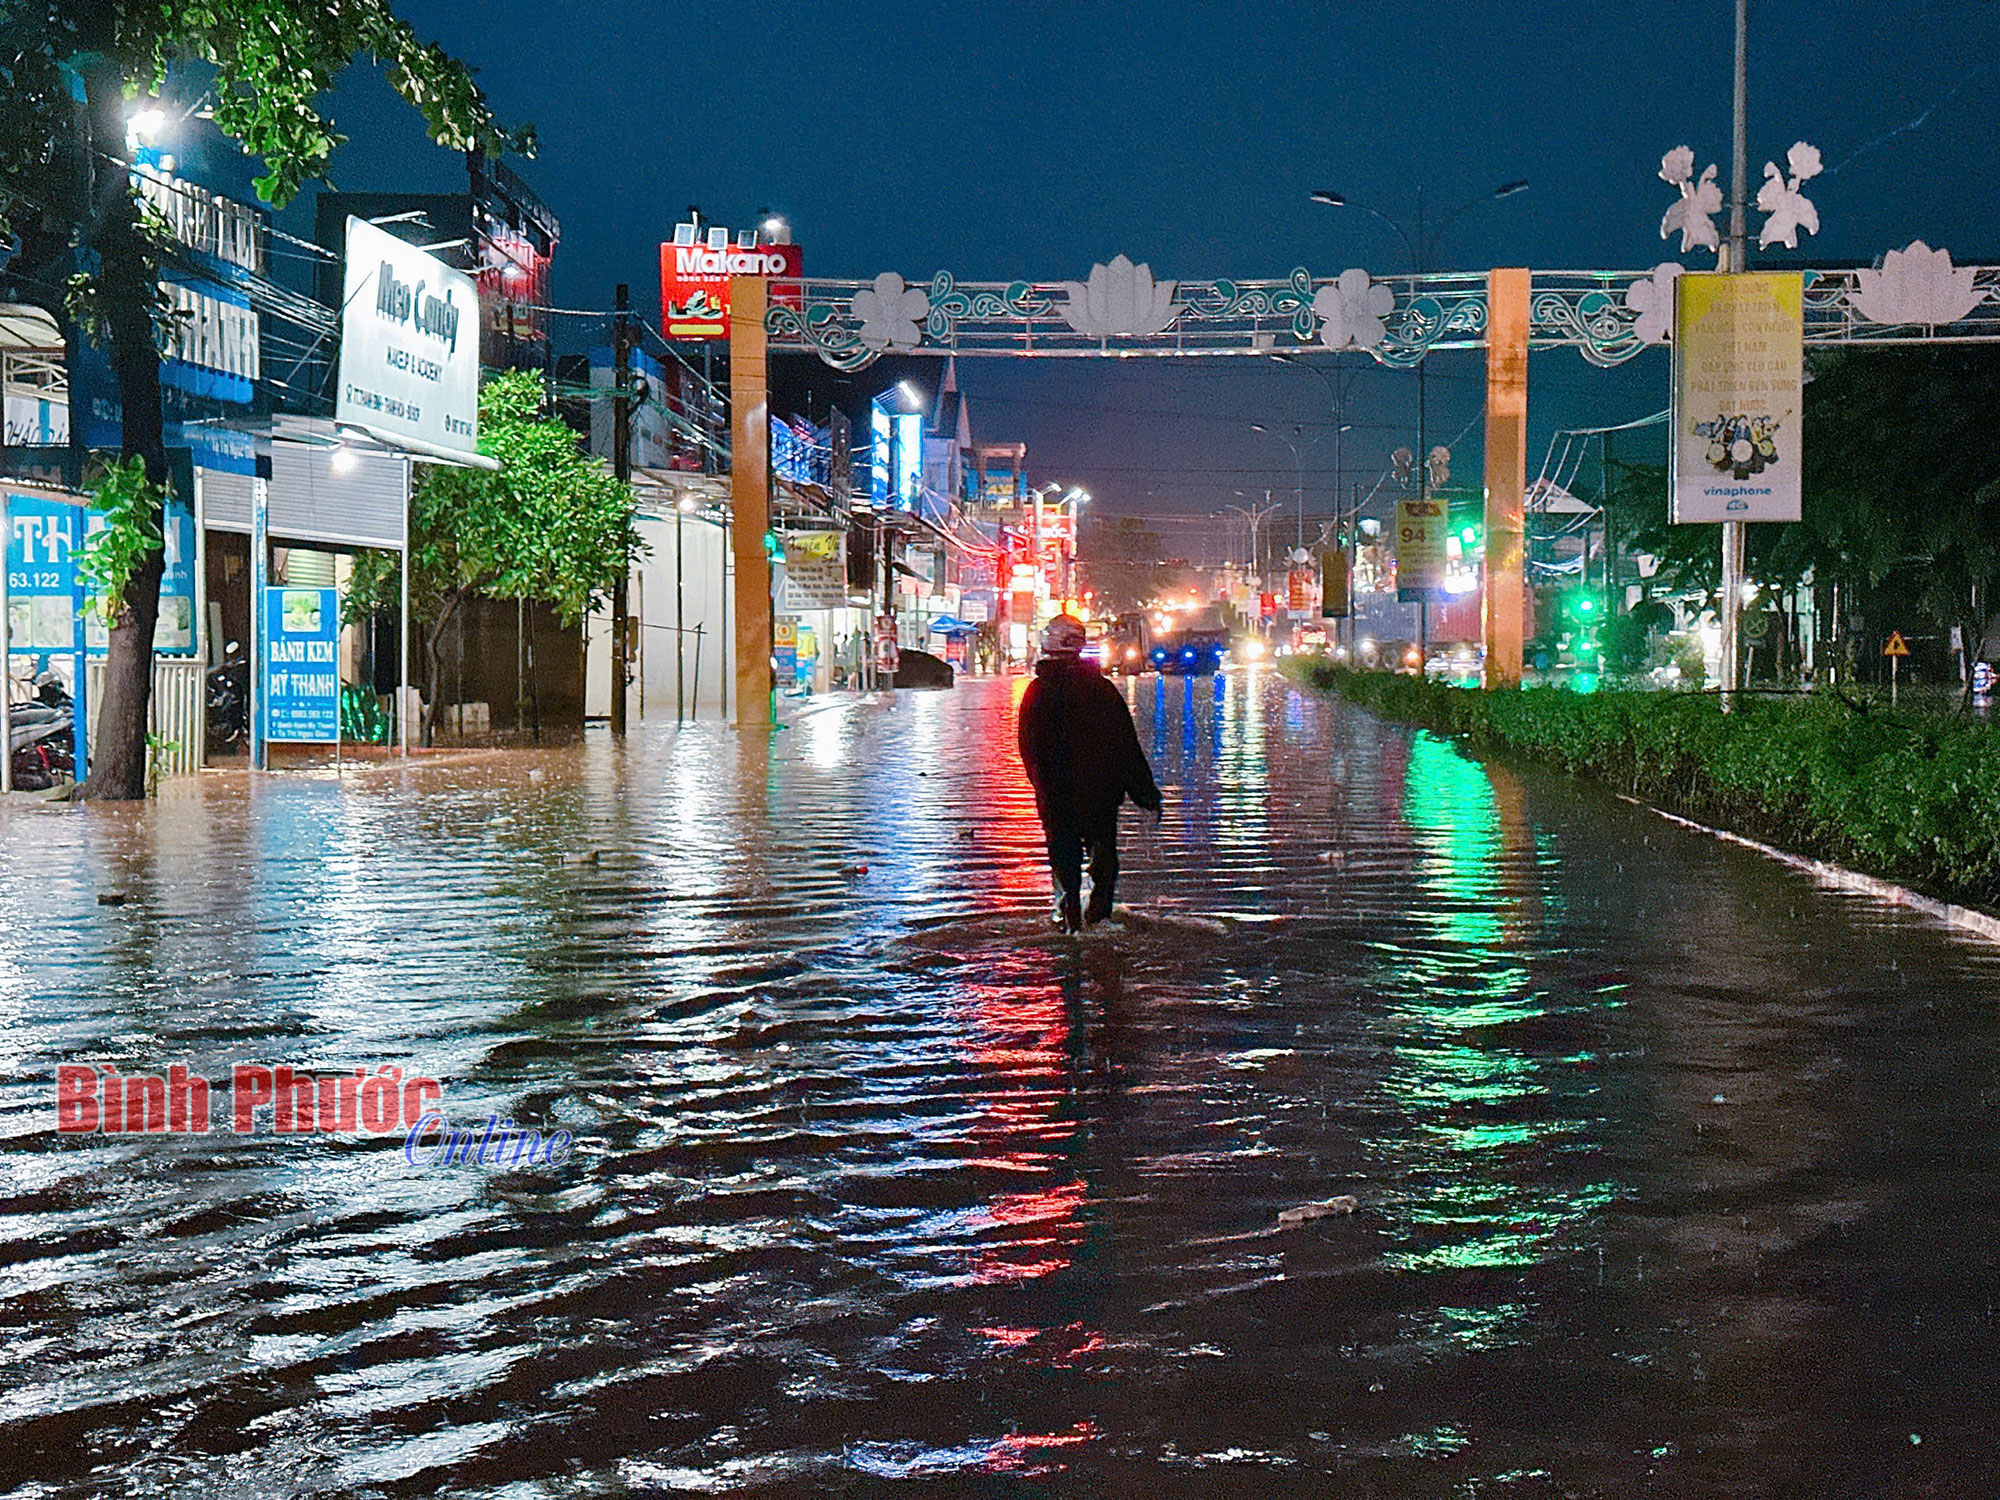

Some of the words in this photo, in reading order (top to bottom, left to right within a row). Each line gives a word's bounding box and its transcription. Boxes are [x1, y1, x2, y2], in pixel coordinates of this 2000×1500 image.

[676, 248, 787, 274] Makano
[1704, 486, 1772, 497] vinaphone
[270, 635, 305, 662] BÁNH
[307, 641, 334, 662] KEM
[290, 674, 335, 697] THANH
